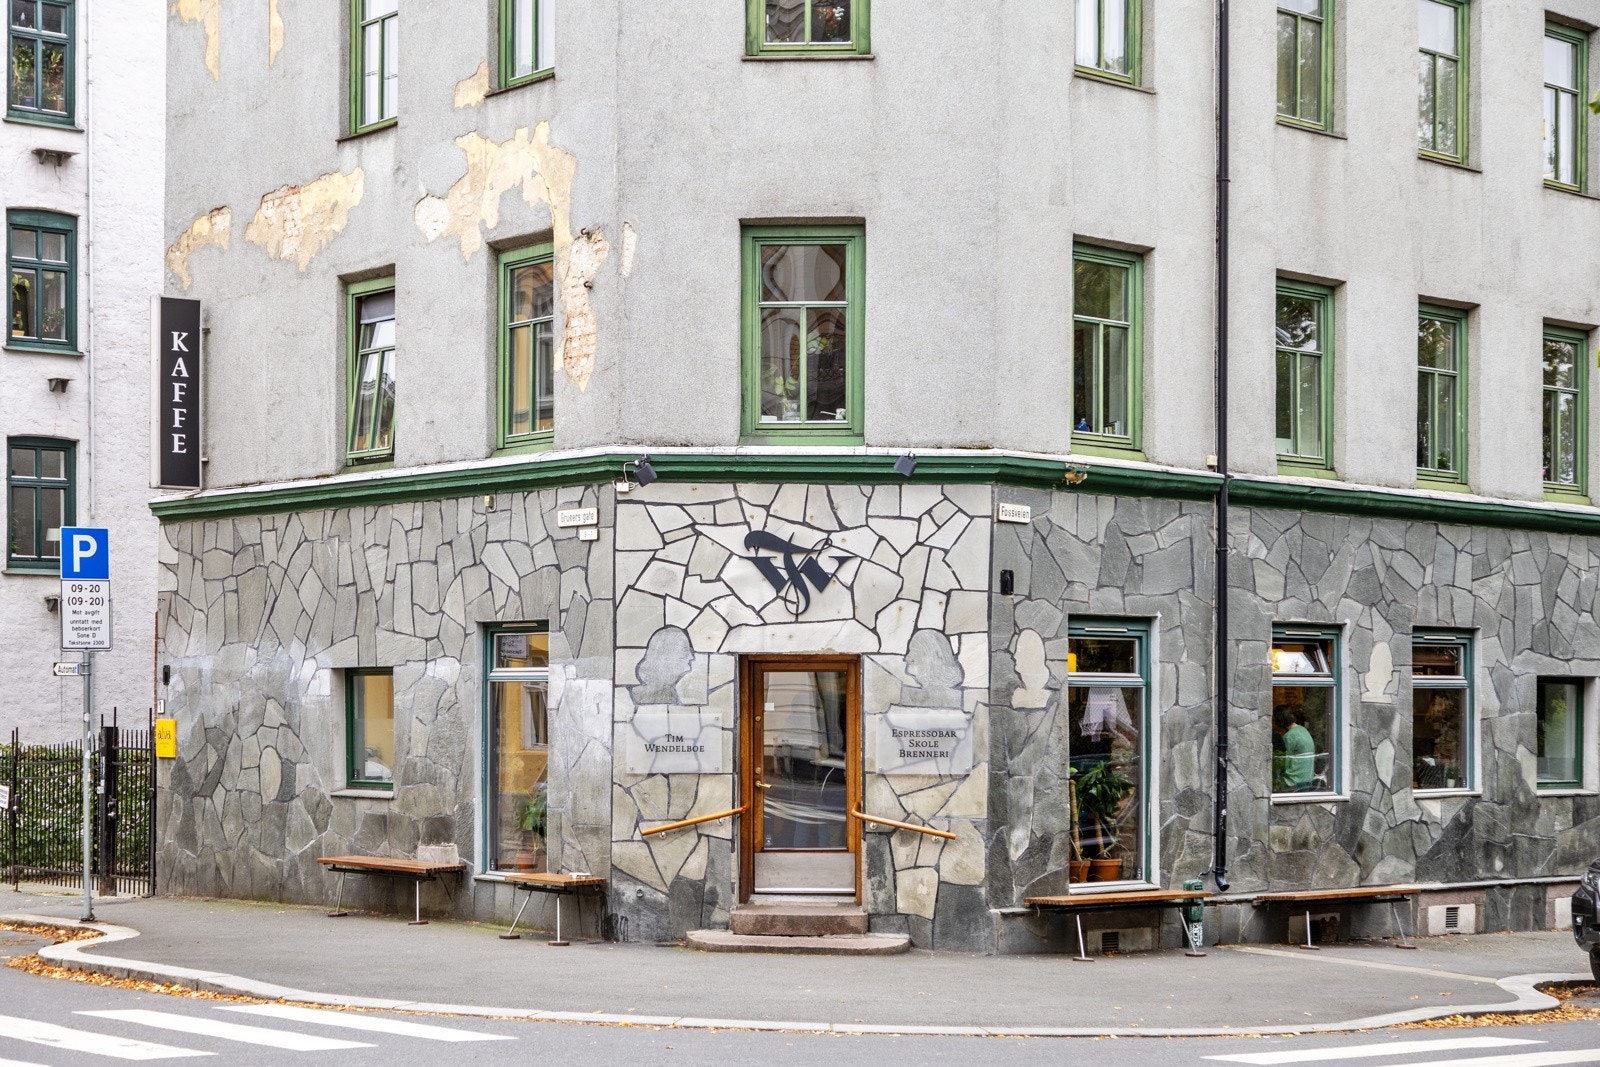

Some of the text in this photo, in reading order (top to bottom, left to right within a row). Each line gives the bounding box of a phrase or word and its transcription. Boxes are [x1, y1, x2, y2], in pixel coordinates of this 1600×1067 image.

[171, 331, 189, 454] KAFFE
[1001, 505, 1029, 519] Fossveien
[583, 511, 595, 523] gate
[72, 534, 97, 573] P
[58, 665, 77, 674] Automat
[665, 734, 684, 742] TIM
[892, 729, 957, 738] ESPRESSOBAR
[909, 739, 939, 748] SKOLE
[644, 744, 705, 753] WENDELBOE
[899, 749, 949, 758] BRENNERI
